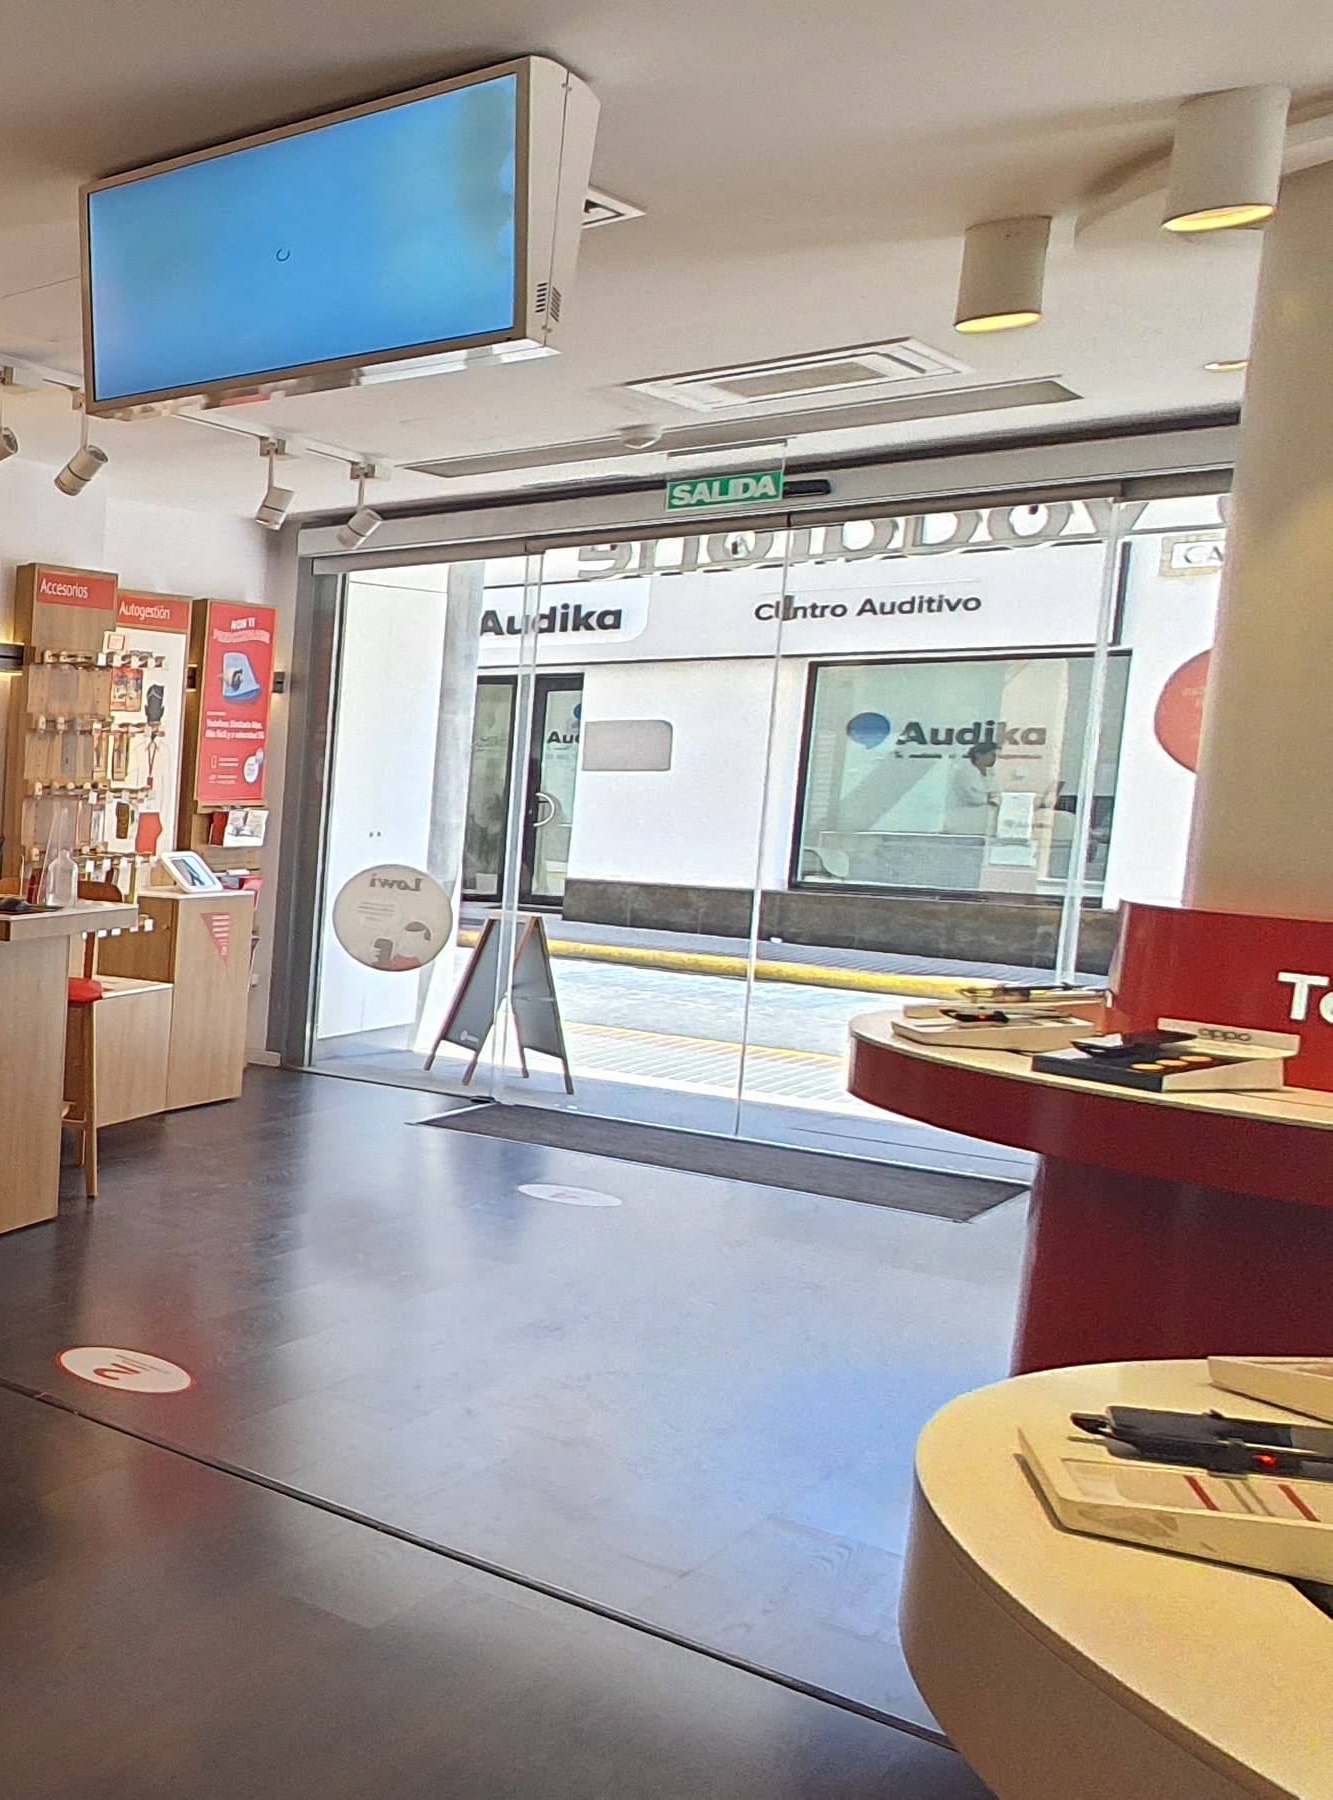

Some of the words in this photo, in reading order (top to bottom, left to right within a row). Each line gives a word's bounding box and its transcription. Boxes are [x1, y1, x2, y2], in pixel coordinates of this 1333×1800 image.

[670, 475, 777, 506] SALIDA
[40, 578, 89, 599] Accesorios
[119, 601, 171, 620] Autogestión
[856, 594, 982, 618] Auditivo
[480, 603, 623, 637] Audika
[895, 720, 1047, 745] Audika
